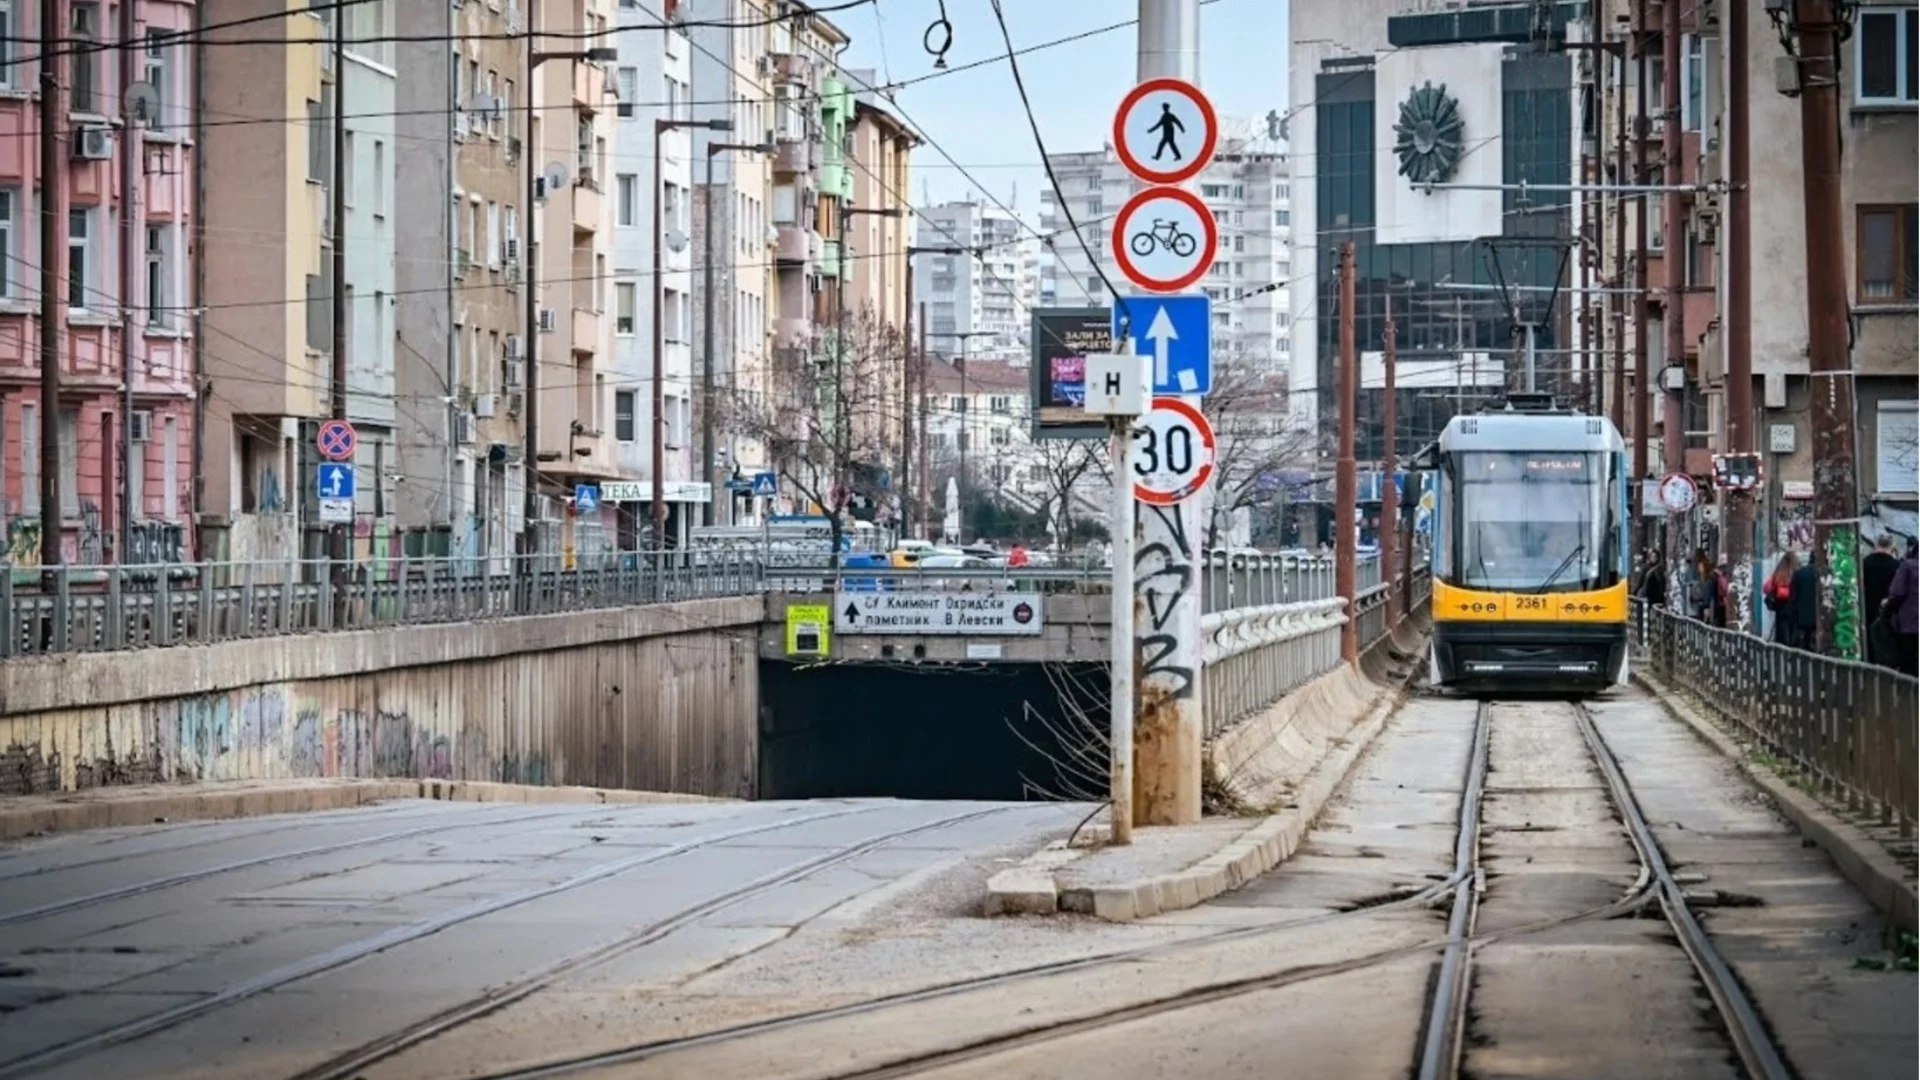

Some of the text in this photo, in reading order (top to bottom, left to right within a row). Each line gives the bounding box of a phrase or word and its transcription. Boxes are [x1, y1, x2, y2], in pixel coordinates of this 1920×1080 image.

[1064, 331, 1110, 340] ЗАЛИ ЗА
[1133, 425, 1192, 476] 30
[887, 596, 940, 609] Климент
[945, 596, 1004, 612] Охридски
[1516, 597, 1547, 609] 2361
[865, 615, 930, 625] паметник
[958, 612, 1004, 626] Левски
